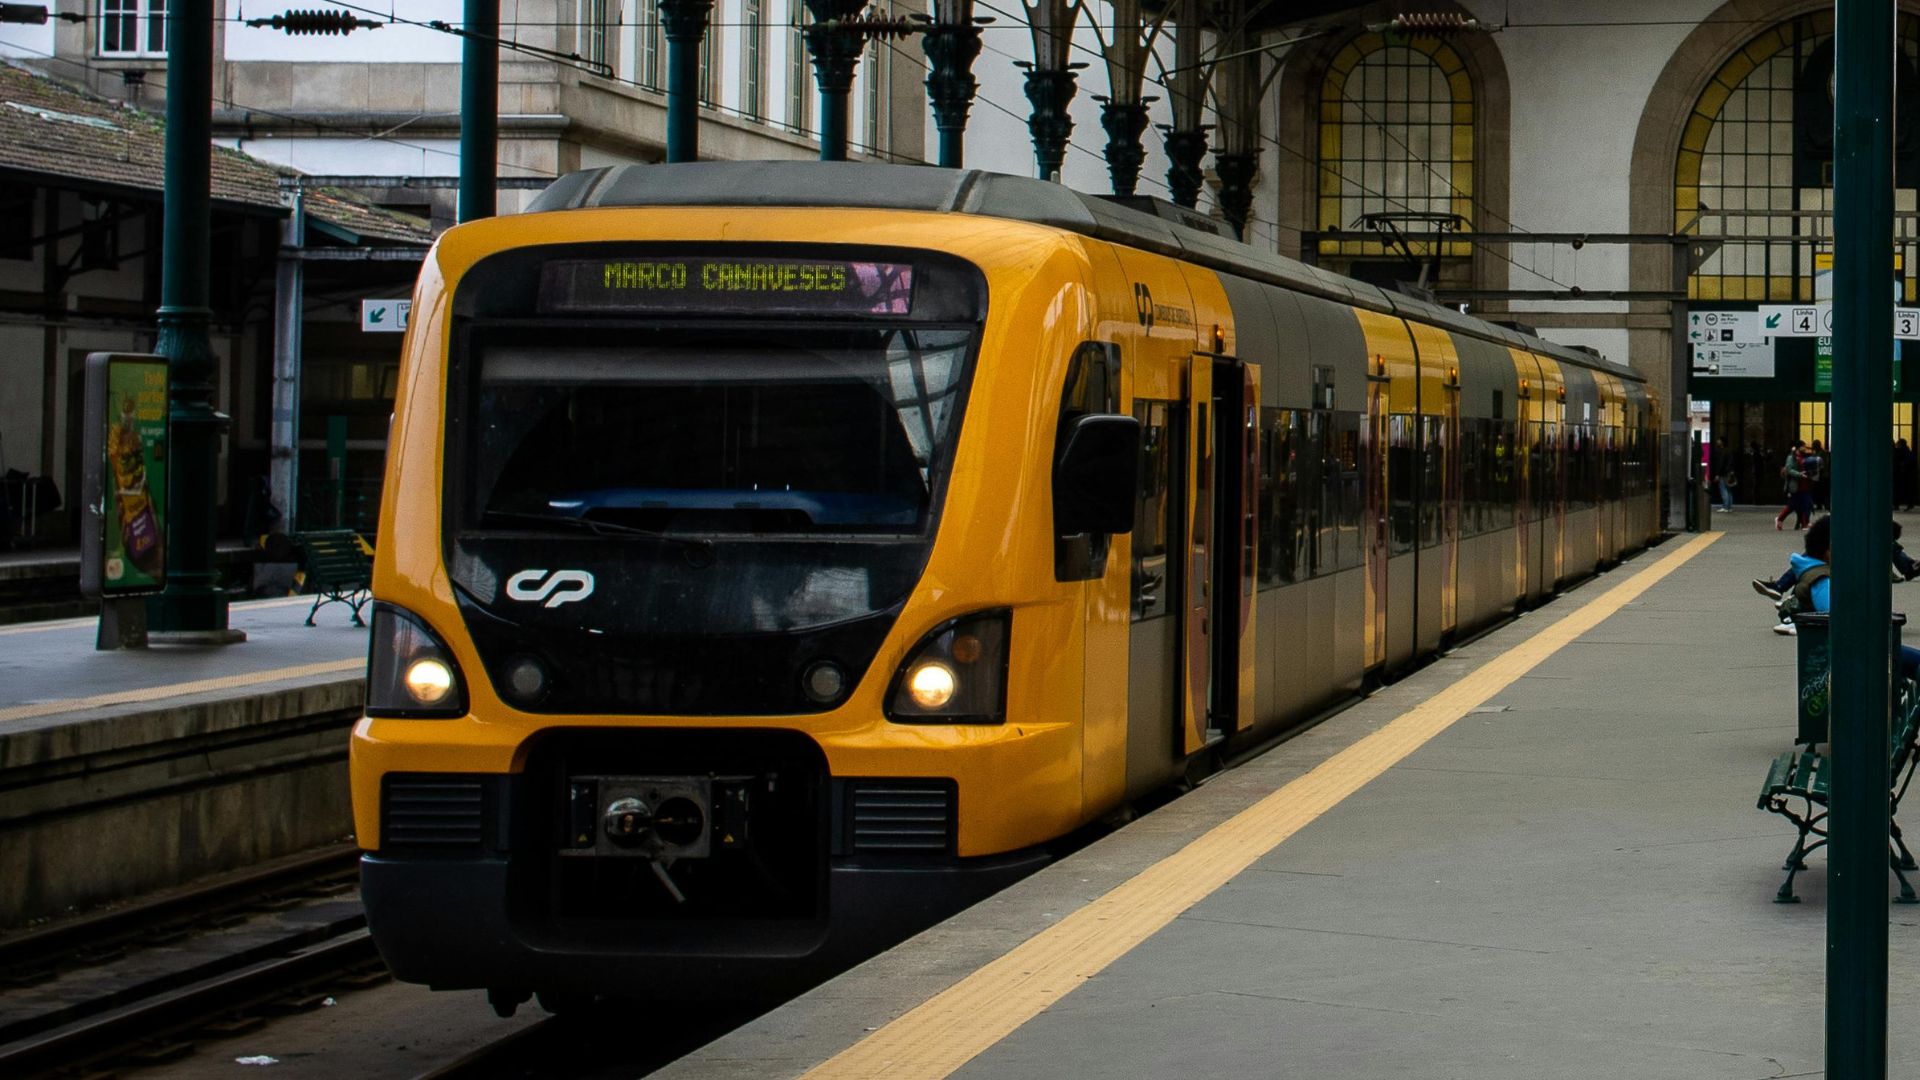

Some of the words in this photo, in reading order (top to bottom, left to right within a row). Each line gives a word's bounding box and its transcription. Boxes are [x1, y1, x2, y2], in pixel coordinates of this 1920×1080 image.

[604, 262, 687, 290] MARCO
[703, 263, 846, 291] CANAVESES
[1799, 316, 1811, 331] 4
[1901, 319, 1911, 334] 3
